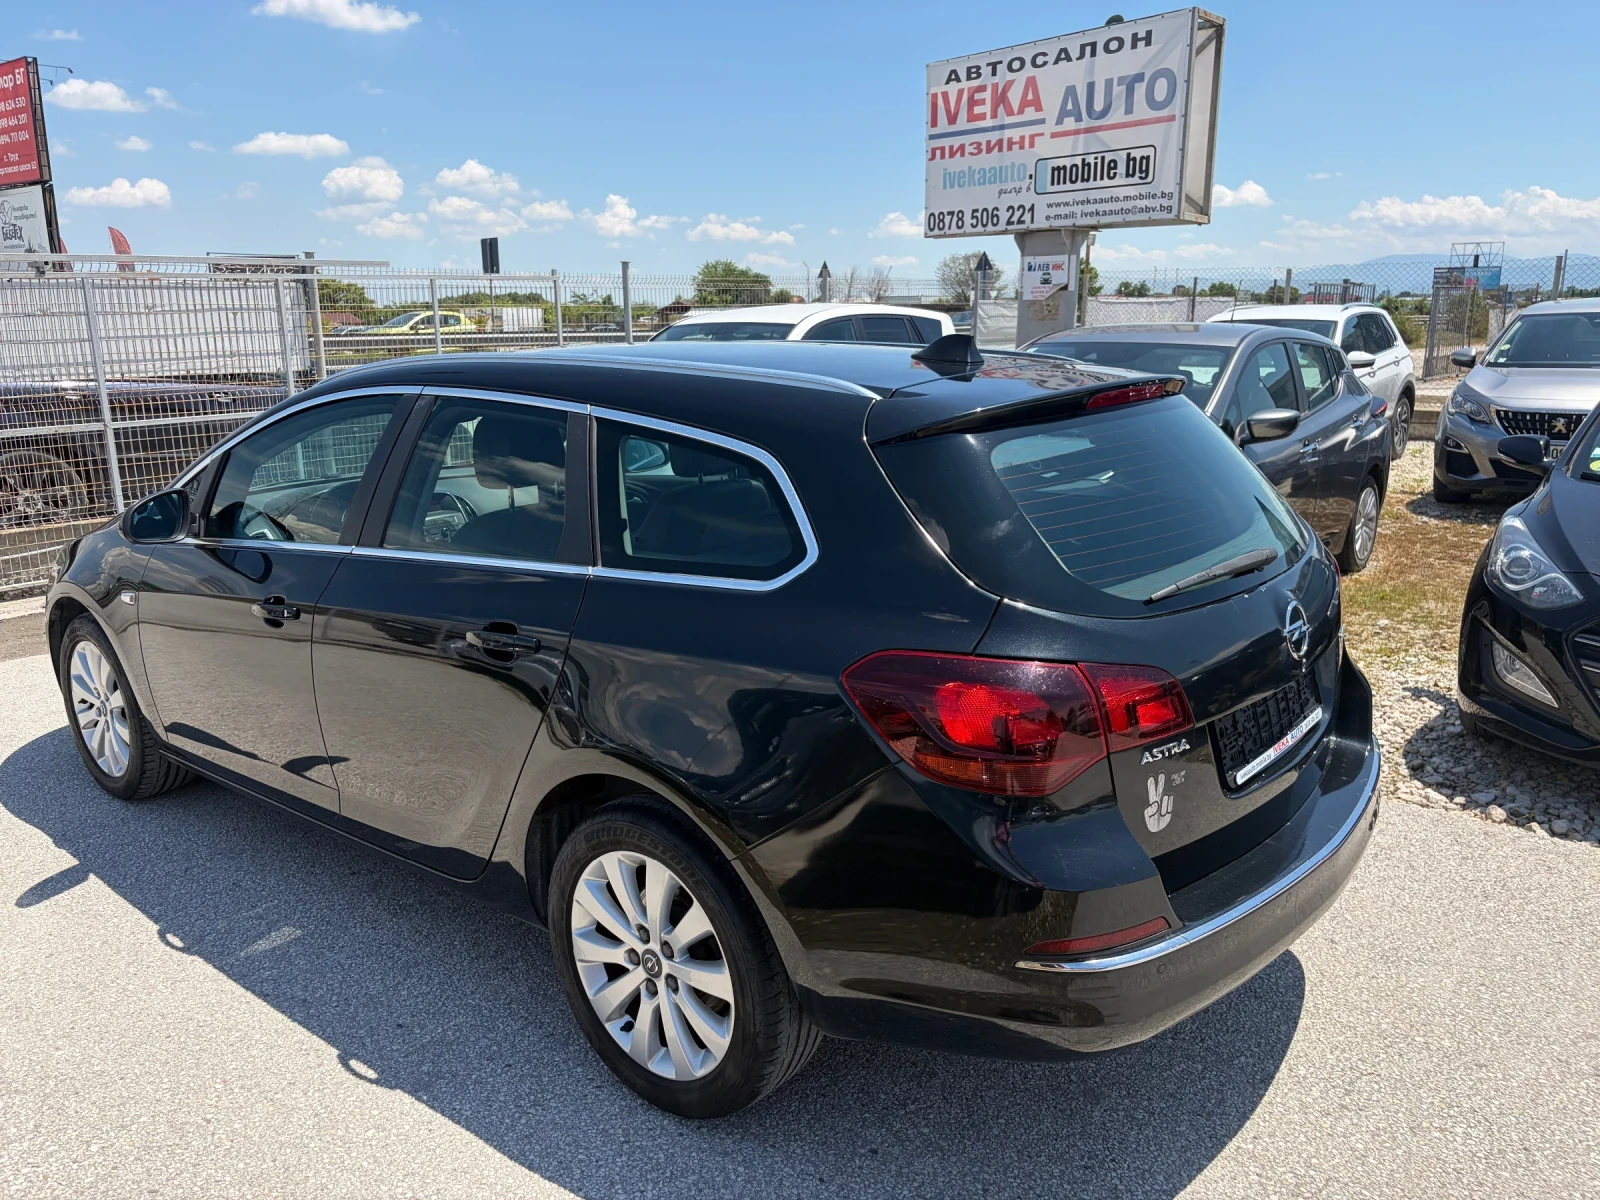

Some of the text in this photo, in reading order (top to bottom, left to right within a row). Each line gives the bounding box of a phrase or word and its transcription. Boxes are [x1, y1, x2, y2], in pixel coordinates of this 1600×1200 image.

[944, 29, 1152, 85] АВТОСАЛОН
[15, 68, 24, 85] БГ
[930, 67, 1177, 128] IVEKA AUTO
[928, 132, 1044, 161] ЛИЗИНГ
[1045, 204, 1173, 221] e-mail: ivekaauto@abv.bg
[1046, 190, 1173, 208] www.ivekaauto.mobile.bg
[928, 203, 1035, 232] 0878 506 221
[1141, 739, 1190, 765] ASTRA
[1272, 737, 1290, 755] IVEKA
[1290, 725, 1304, 741] AUTO
